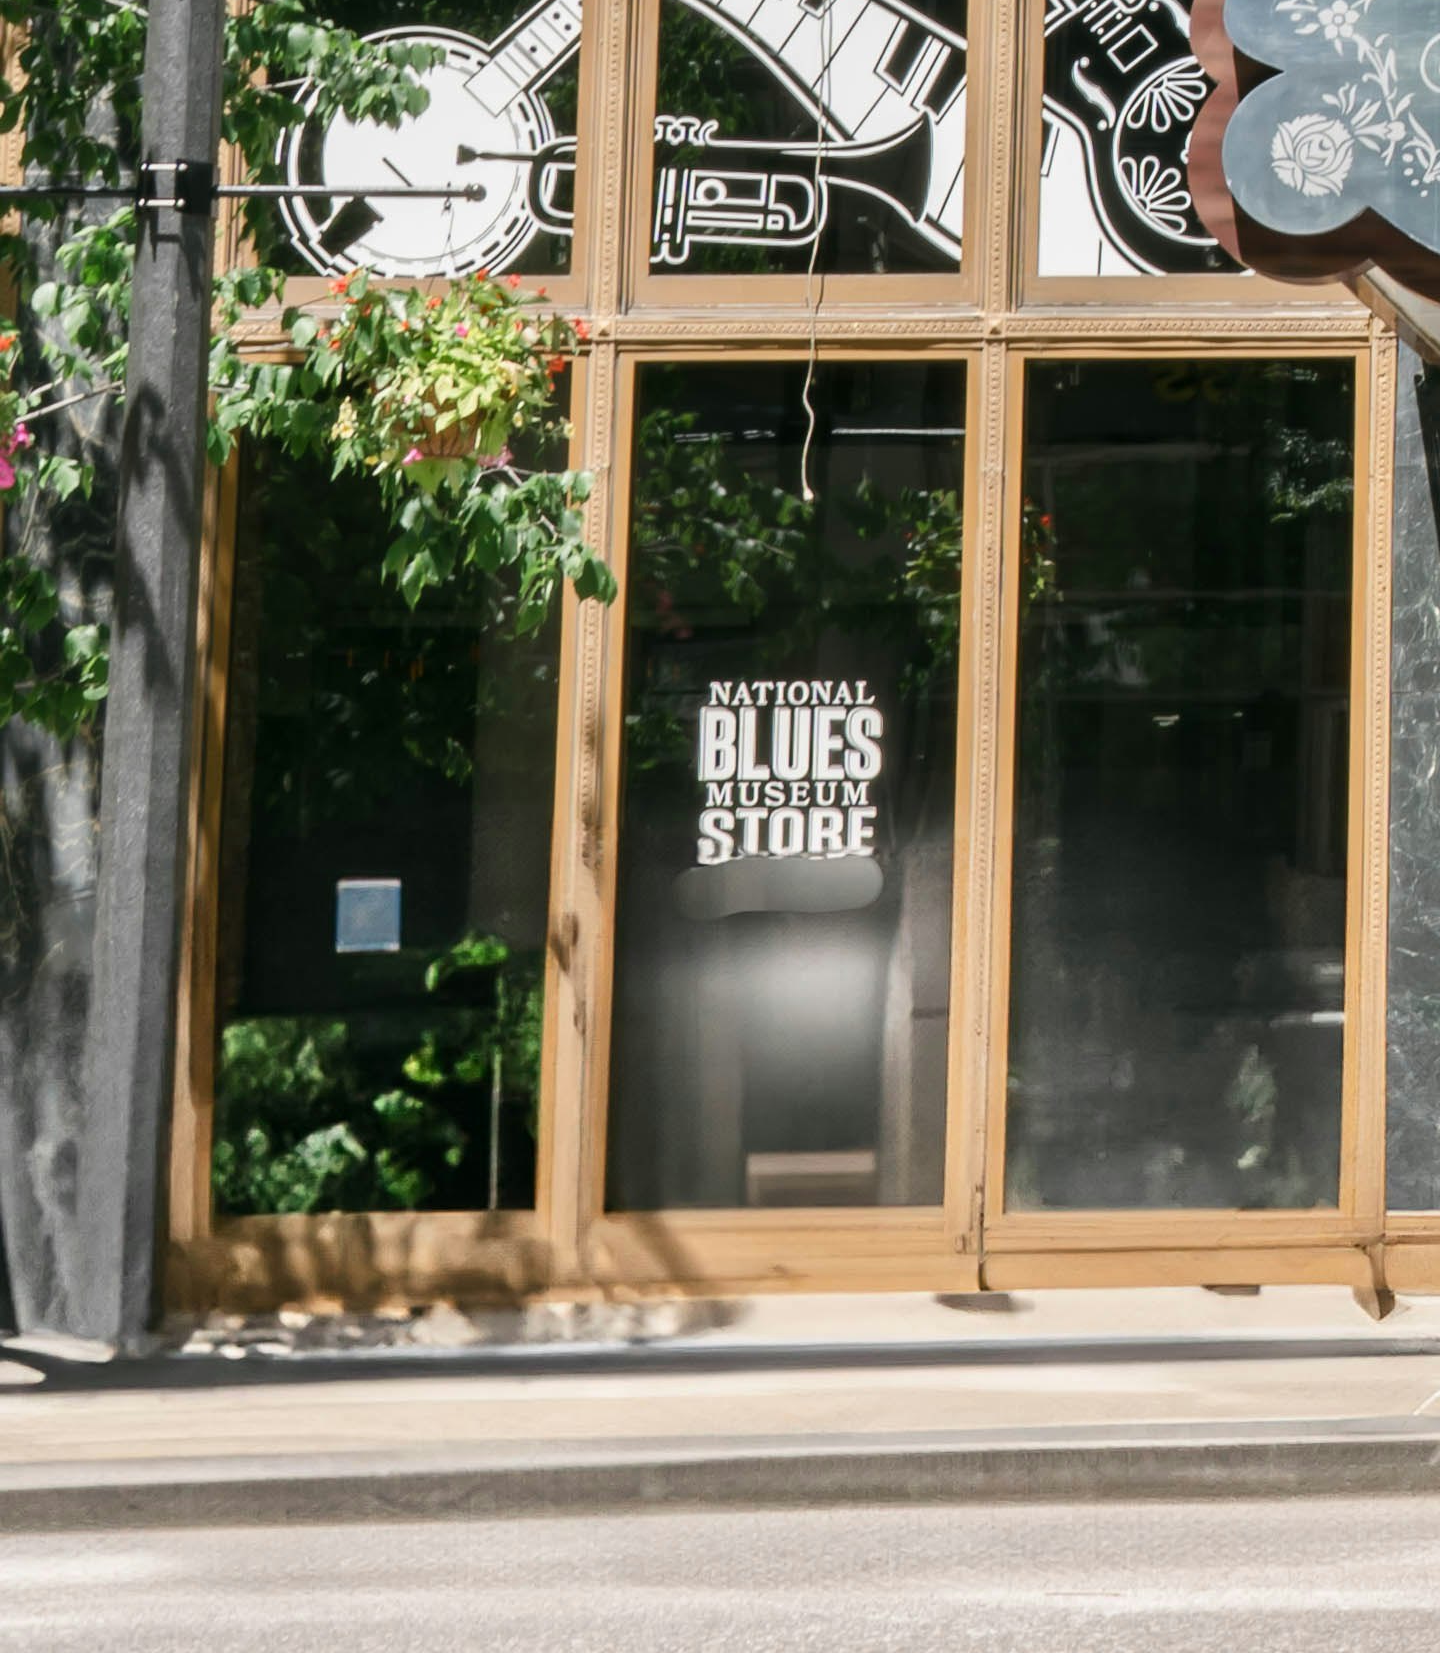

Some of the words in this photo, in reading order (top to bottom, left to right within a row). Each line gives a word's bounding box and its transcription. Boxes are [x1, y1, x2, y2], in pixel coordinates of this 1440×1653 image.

[708, 680, 876, 707] NATIONAL
[698, 706, 884, 781] BLUES
[705, 780, 870, 807] MUSEUM
[697, 806, 877, 864] STORE
